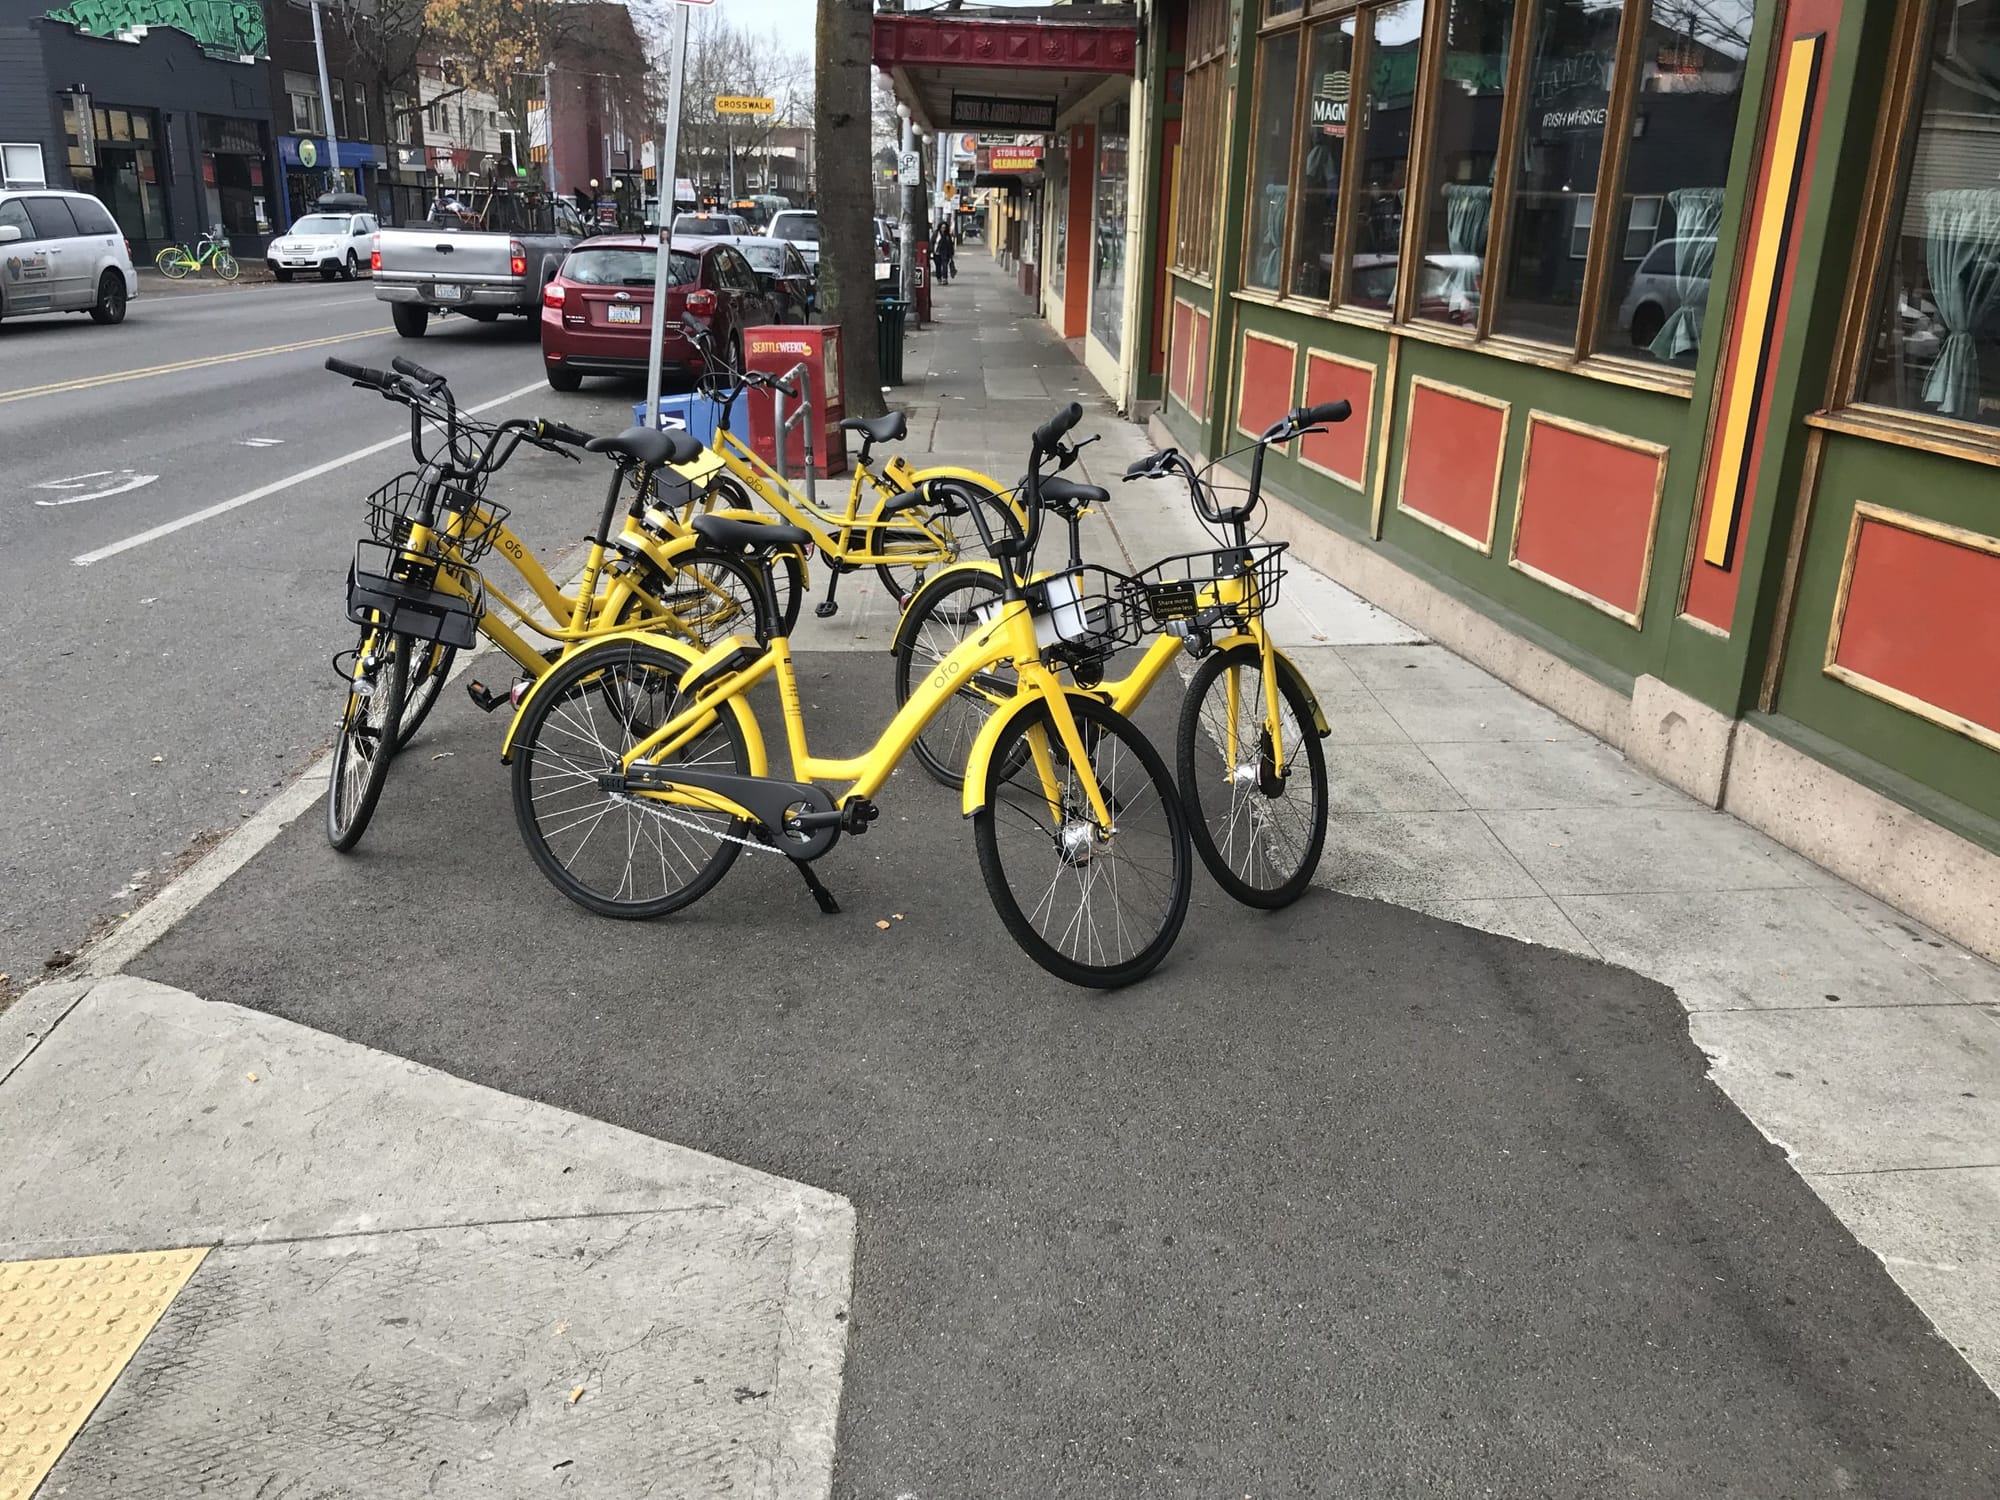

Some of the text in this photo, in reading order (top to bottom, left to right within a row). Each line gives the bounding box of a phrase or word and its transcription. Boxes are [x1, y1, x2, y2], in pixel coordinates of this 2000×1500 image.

[718, 100, 772, 110] CROSSWALK
[1313, 100, 1349, 121] MAGN
[1542, 111, 1567, 128] IRISH
[996, 149, 1036, 157] STORE WIDE
[992, 158, 1036, 169] CLEARANC
[746, 475, 763, 491] ofo
[505, 540, 523, 559] ofo
[934, 661, 959, 688] ofo
